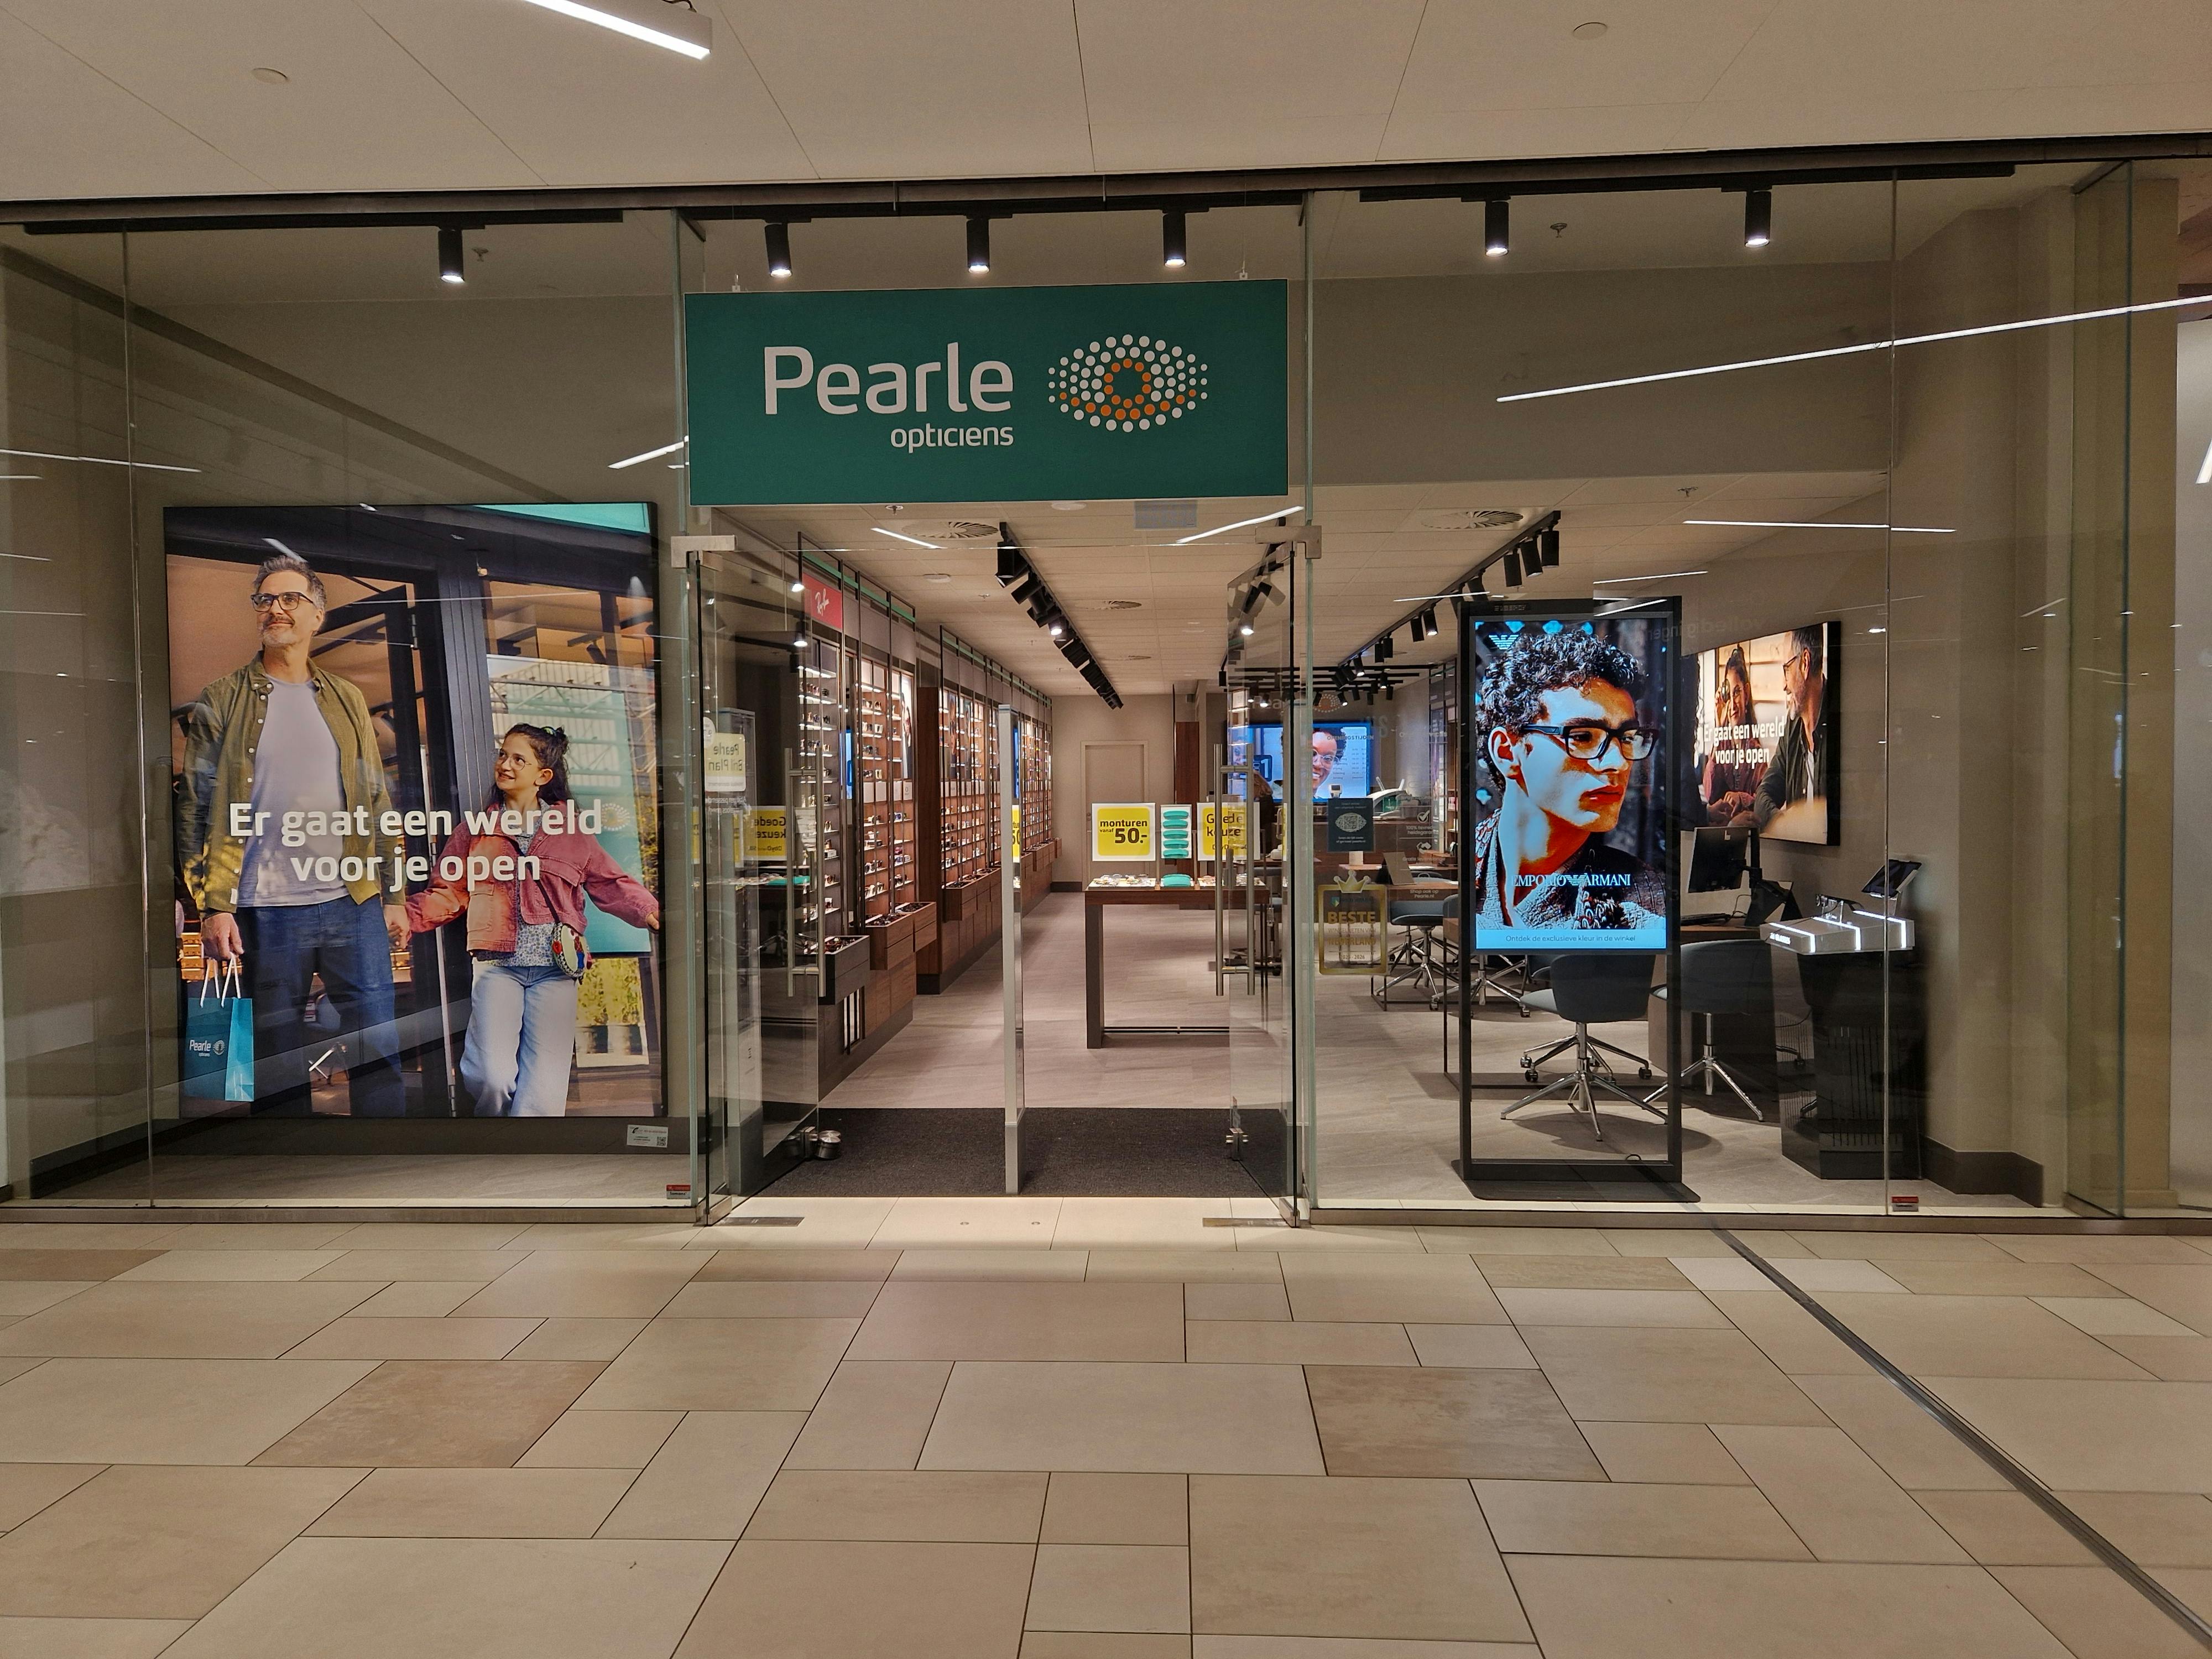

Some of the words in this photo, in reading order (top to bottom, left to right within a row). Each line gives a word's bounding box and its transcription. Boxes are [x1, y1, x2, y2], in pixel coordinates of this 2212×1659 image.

[764, 342, 1014, 415] Pearle
[890, 422, 1014, 453] opticiens
[1704, 725, 1713, 742] Er
[1714, 724, 1732, 746] gaat
[1734, 725, 1749, 739] een
[1751, 716, 1785, 739] wereld
[1715, 749, 1734, 764] voor
[1735, 745, 1745, 769] je
[1746, 748, 1768, 768] open
[229, 802, 270, 837] Er
[281, 804, 369, 848] gaat
[379, 809, 453, 837] een
[465, 799, 602, 836] wereld
[1207, 813, 1243, 823] Gede
[1115, 828, 1147, 843] 50.-
[1207, 826, 1241, 837] kuze
[290, 855, 382, 883] voor
[389, 847, 429, 893] je
[439, 853, 541, 891] open
[1584, 874, 1630, 886] ARMANI
[1327, 911, 1376, 924] BESTE
[190, 1040, 211, 1051] Pearle
